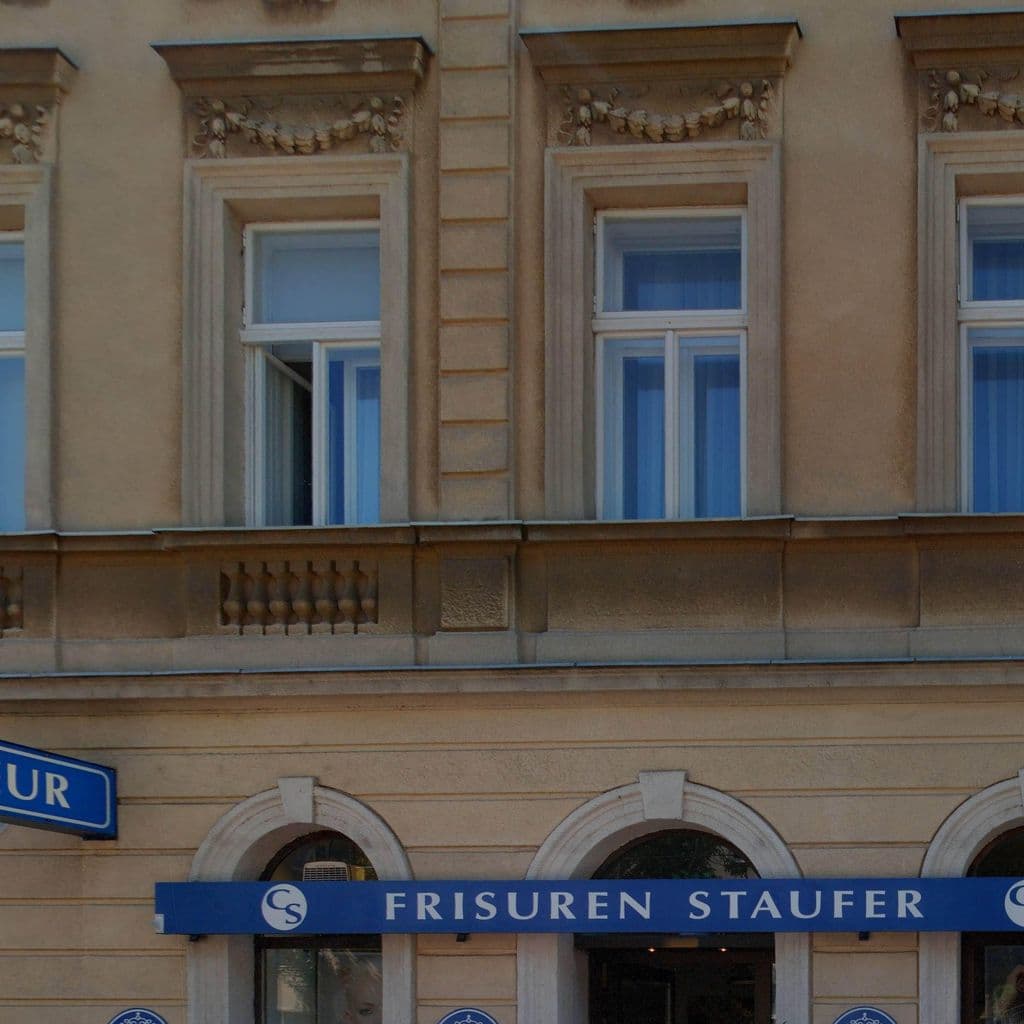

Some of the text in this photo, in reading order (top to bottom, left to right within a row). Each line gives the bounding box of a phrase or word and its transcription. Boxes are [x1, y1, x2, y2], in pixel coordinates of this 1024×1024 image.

[265, 888, 303, 925] CS
[385, 890, 924, 921] FRISUREN STAUFER
